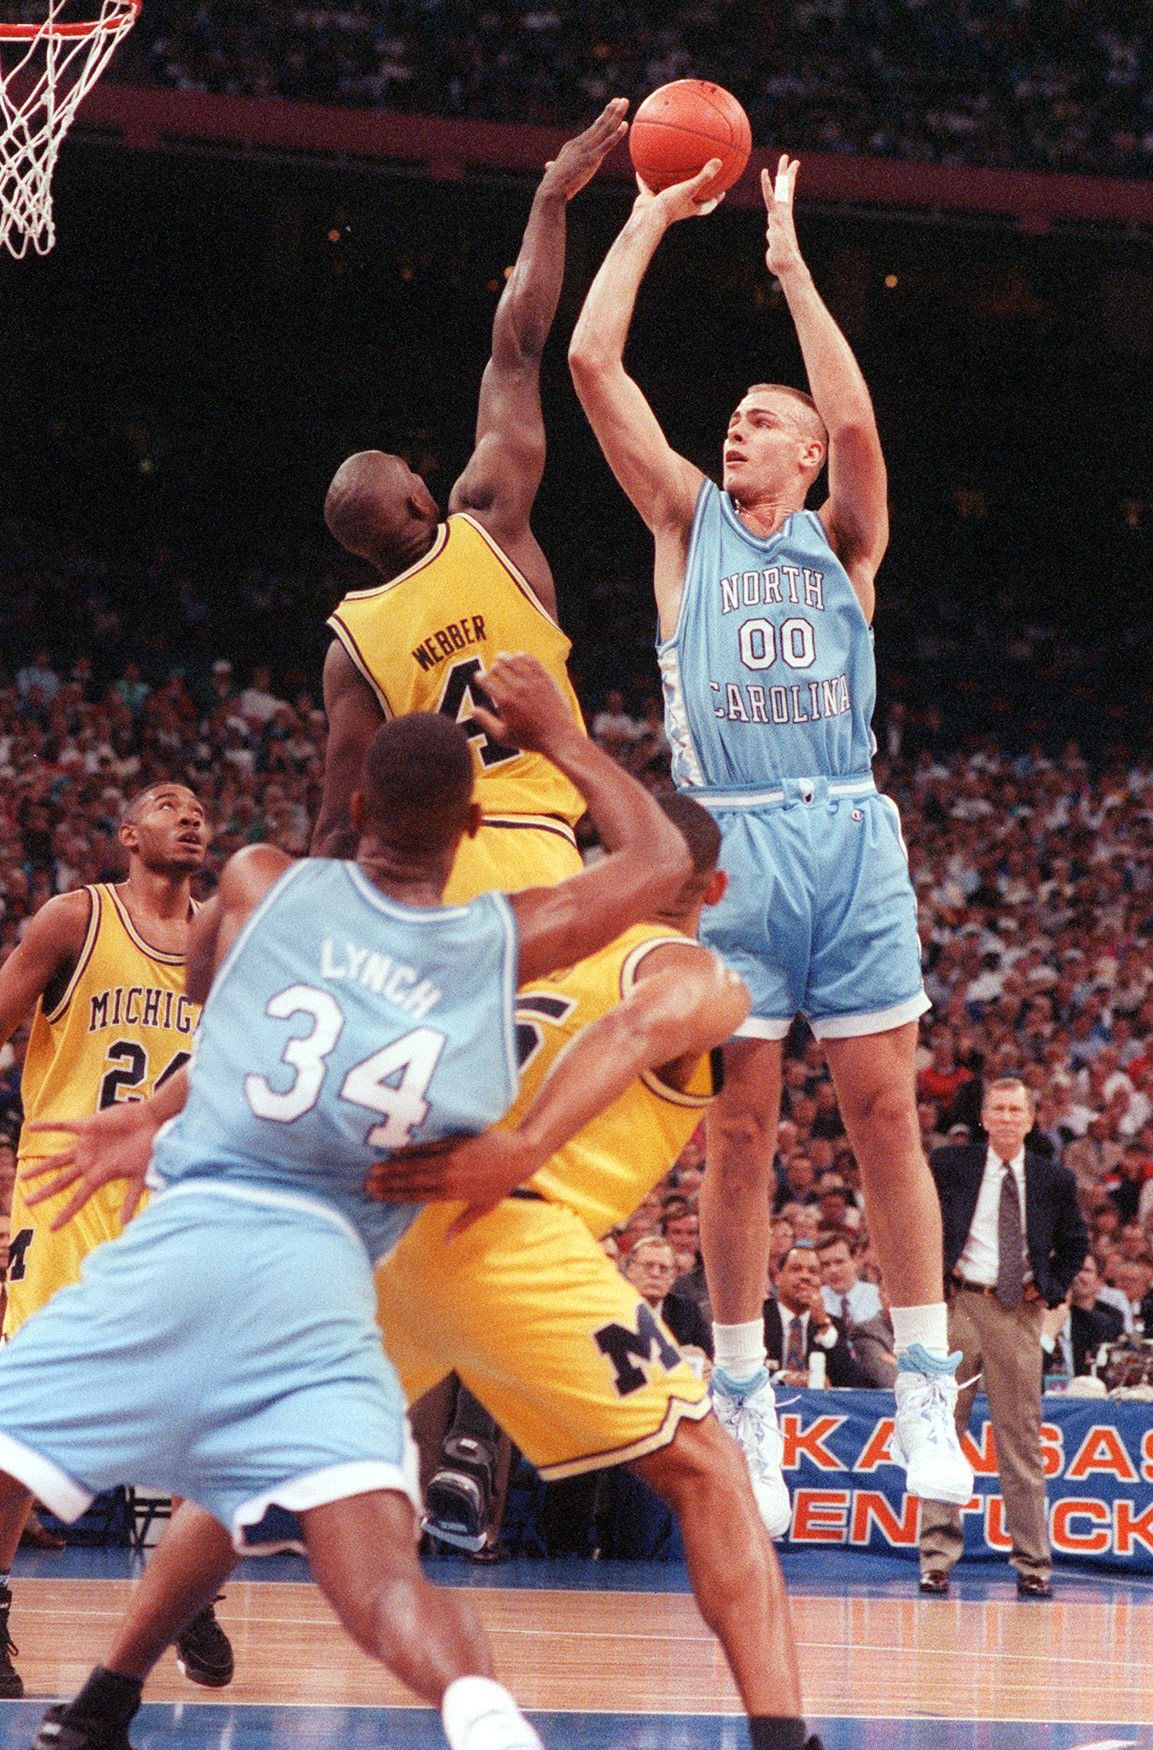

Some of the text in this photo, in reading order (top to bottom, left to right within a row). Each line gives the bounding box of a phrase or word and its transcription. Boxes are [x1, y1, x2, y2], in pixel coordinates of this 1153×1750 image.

[720, 564, 825, 615] NORTH
[411, 614, 488, 672] WEBBER
[738, 617, 816, 670] 00
[435, 655, 524, 771] 4
[88, 986, 204, 1036] MICHIG
[321, 937, 443, 1020] LYNCH
[244, 982, 448, 1149] 34
[592, 1300, 682, 1397] M
[780, 1413, 1153, 1483] KANA
